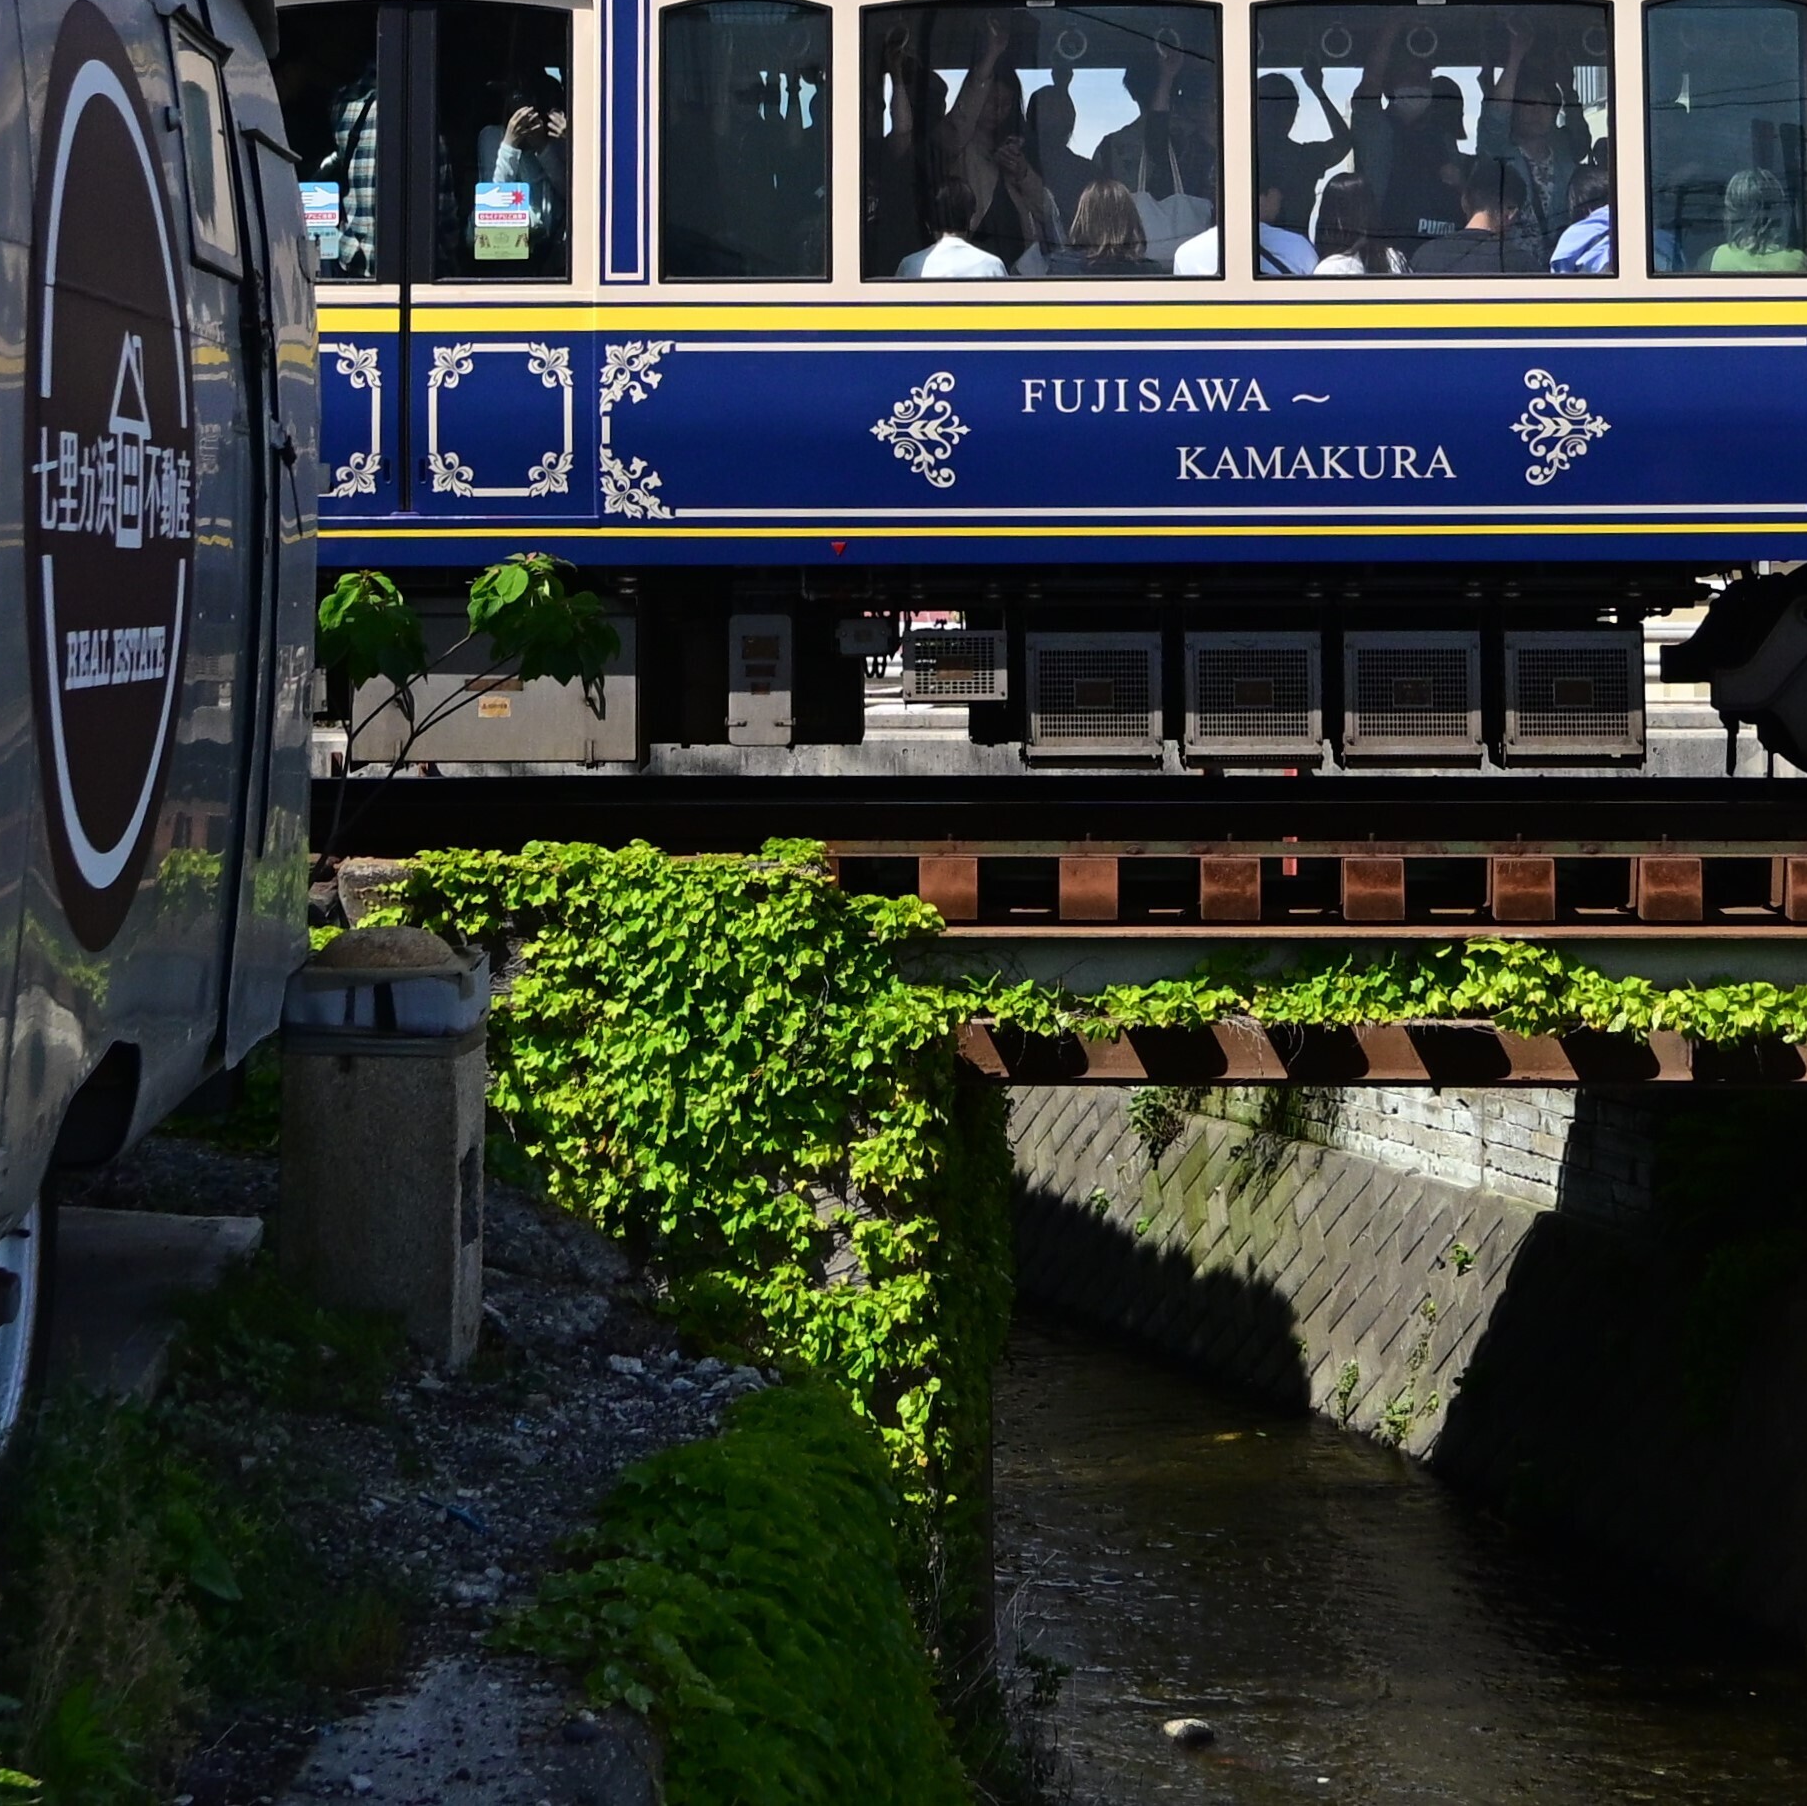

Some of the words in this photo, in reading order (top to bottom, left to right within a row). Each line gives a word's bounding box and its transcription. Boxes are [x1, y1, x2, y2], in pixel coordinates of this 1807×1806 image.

[1418, 218, 1456, 235] PUMA
[1021, 378, 1271, 413] FUJISAWA
[1176, 445, 1457, 480] KAMAKURA
[144, 446, 192, 541] 不動産
[65, 628, 112, 691] REAL
[111, 625, 167, 685] ESTATE
